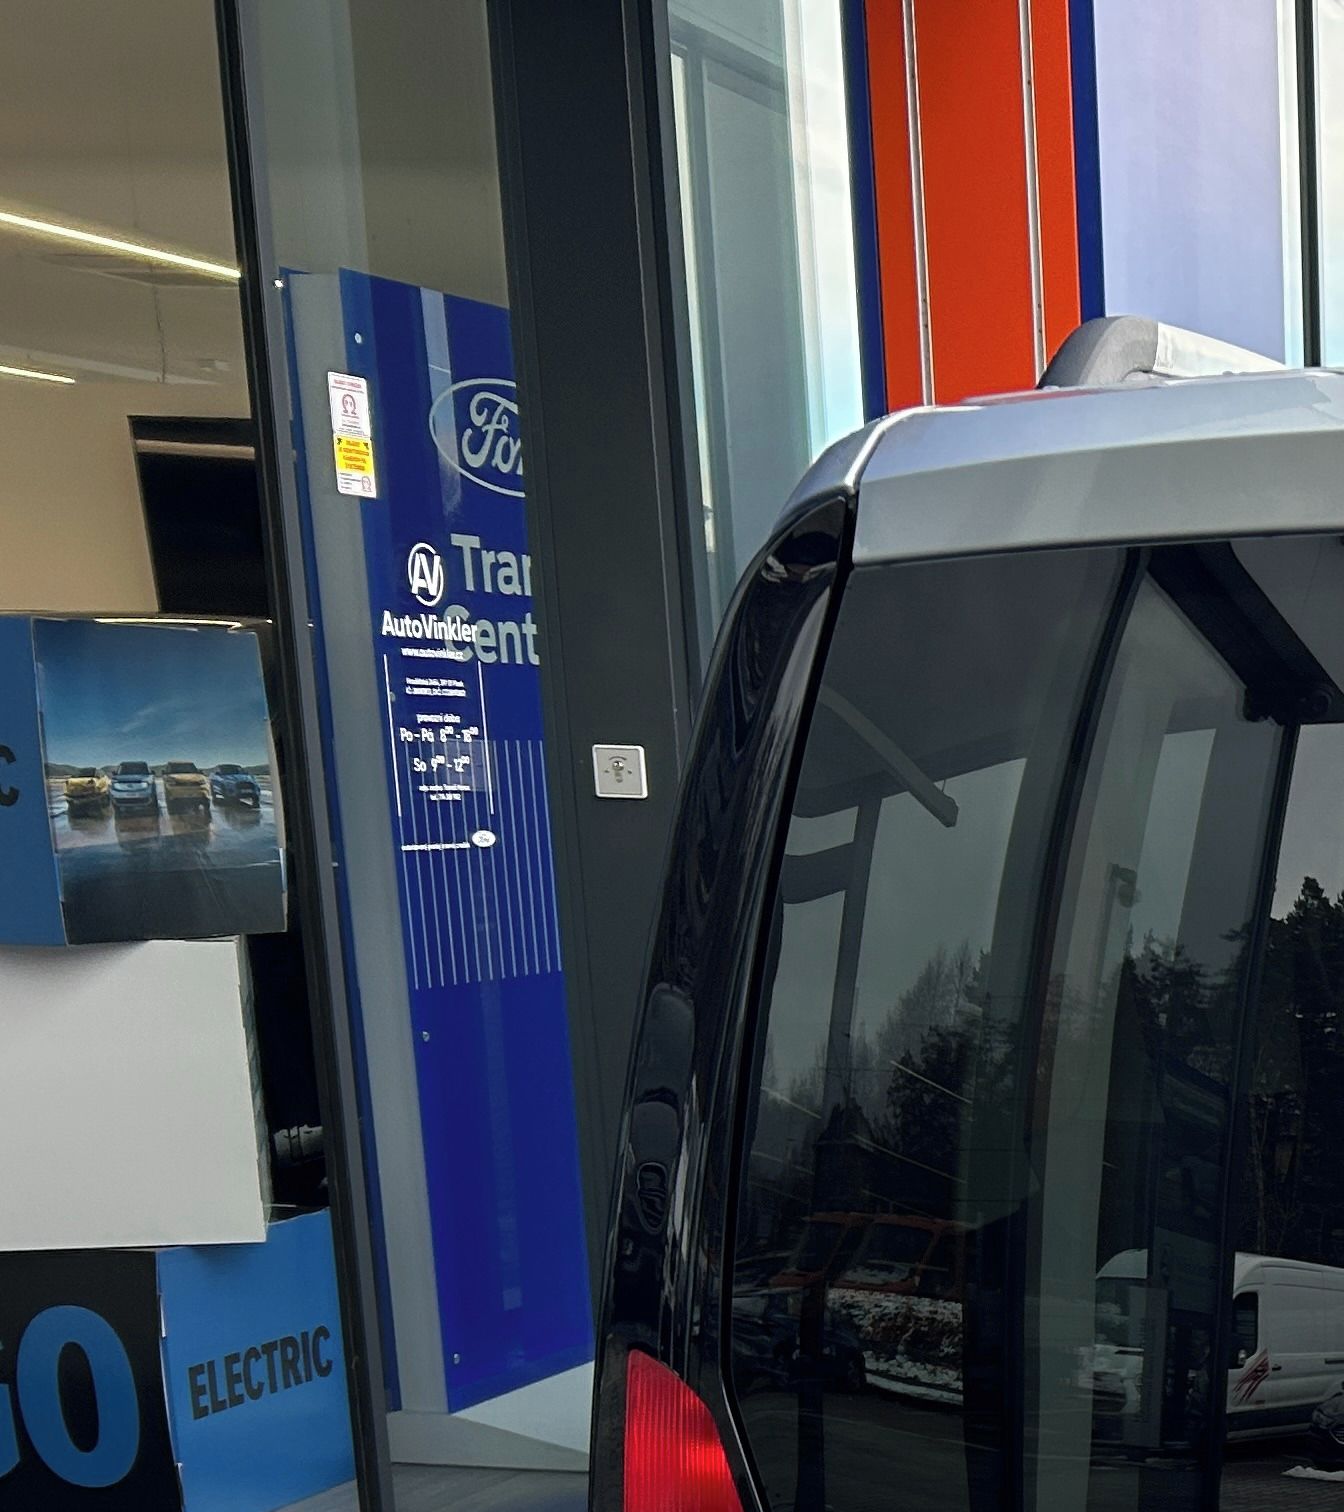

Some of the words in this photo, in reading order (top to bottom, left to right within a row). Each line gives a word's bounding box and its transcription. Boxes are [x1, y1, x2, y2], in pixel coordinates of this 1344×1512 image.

[461, 391, 524, 476] Fo
[382, 610, 478, 642] AutoVinkler
[187, 1325, 333, 1421] ELECTRIC
